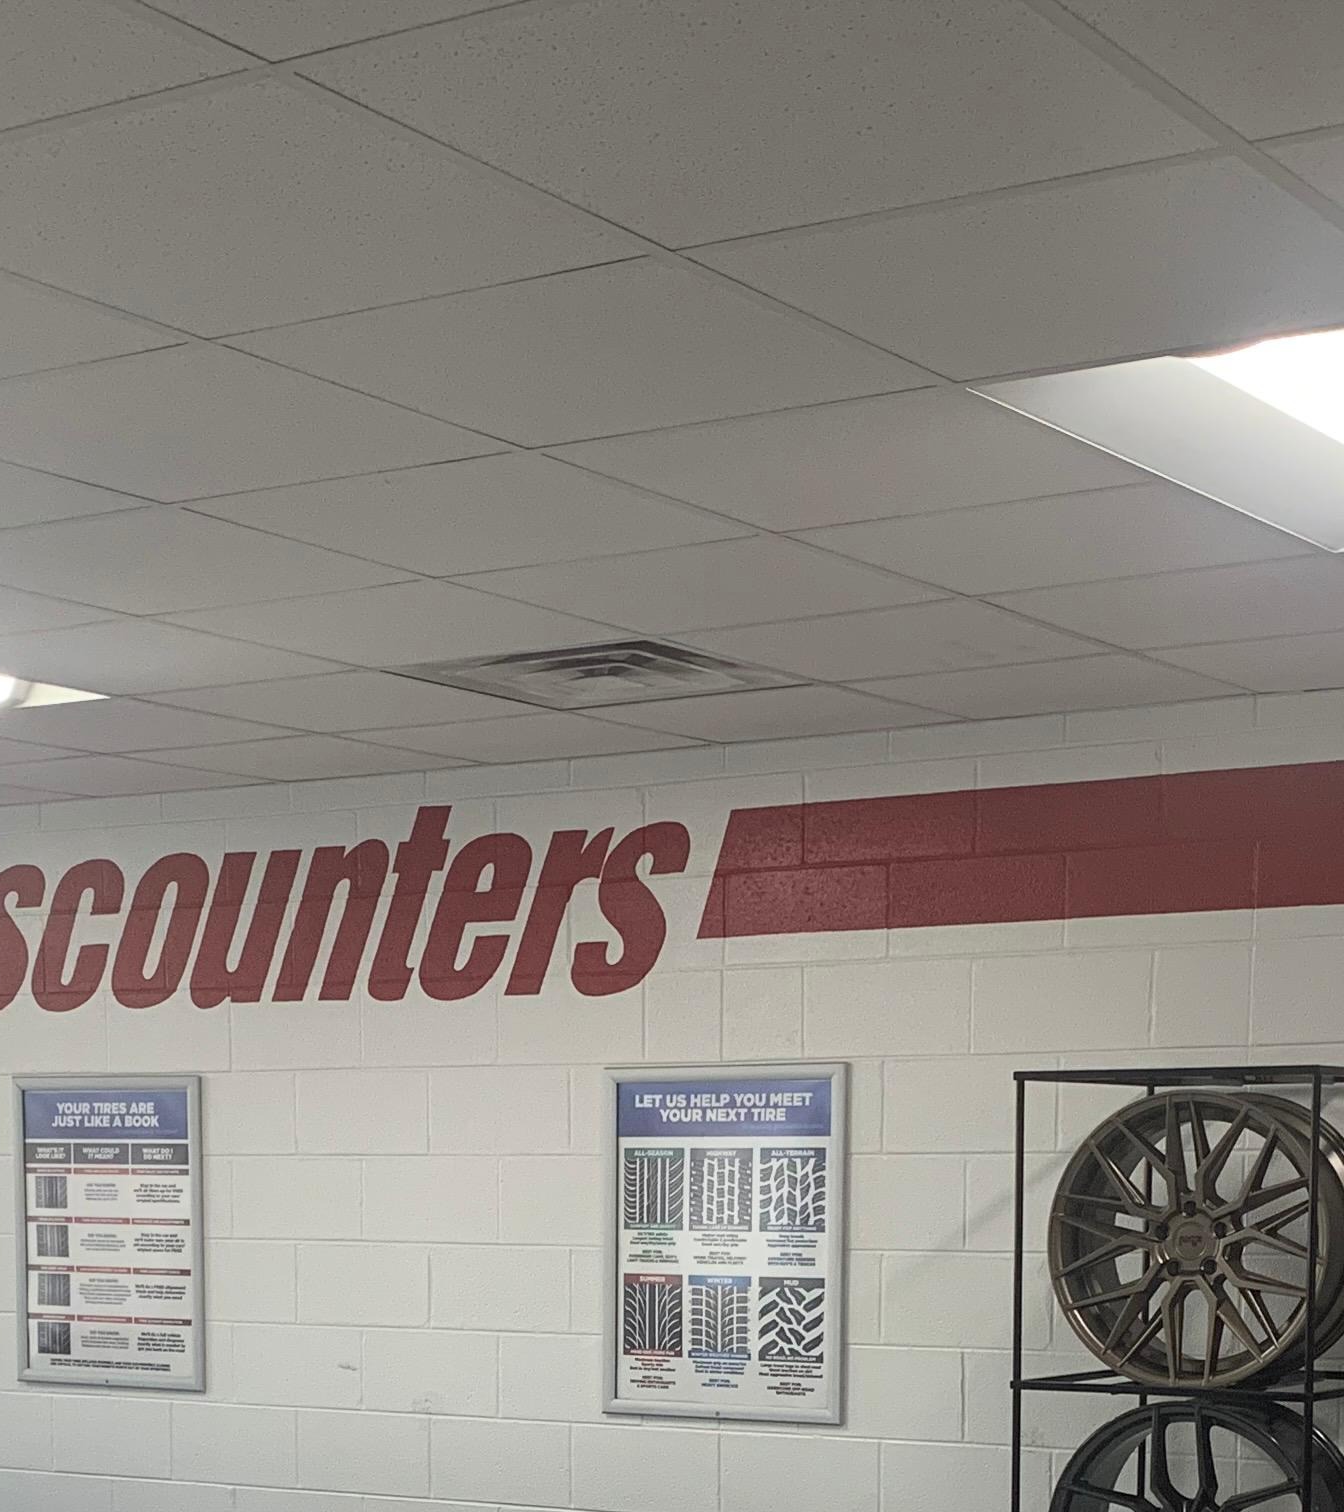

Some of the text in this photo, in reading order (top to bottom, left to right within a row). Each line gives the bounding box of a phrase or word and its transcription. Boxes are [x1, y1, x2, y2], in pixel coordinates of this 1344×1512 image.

[635, 1092, 813, 1108] LET US HELP YOU MEET
[56, 1102, 154, 1115] YOUR TIRES ARE
[660, 1108, 786, 1122] YOUR NEXT TIRE
[52, 1115, 159, 1128] JUST LIKE A BOOK
